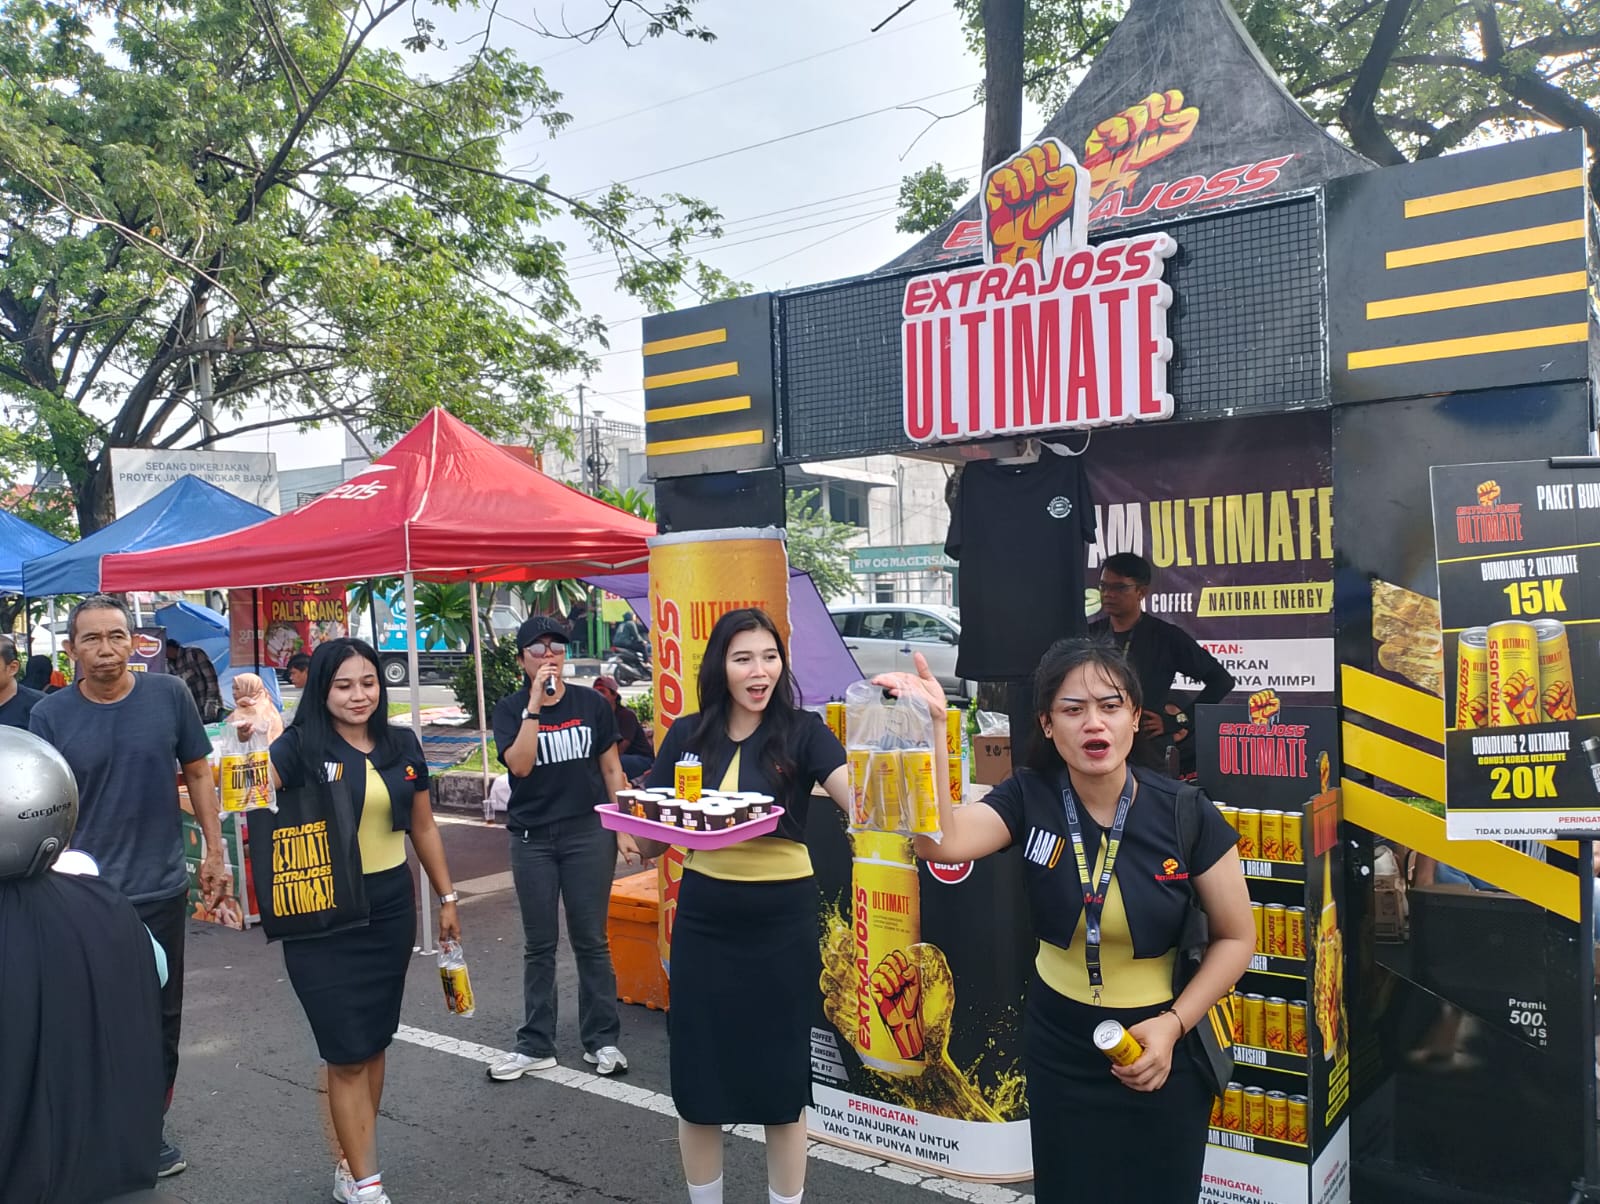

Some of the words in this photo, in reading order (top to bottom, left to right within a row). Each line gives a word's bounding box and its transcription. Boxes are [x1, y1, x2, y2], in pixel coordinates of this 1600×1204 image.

[904, 239, 1158, 316] EXTRAJOSS
[905, 283, 1162, 440] ULTIMATE
[119, 473, 161, 482] PROYEK
[243, 475, 273, 483] BARAT
[146, 462, 187, 471] SEDANG
[190, 463, 250, 472] DIKERJAKAN
[1537, 484, 1573, 510] PAKET
[1150, 487, 1334, 568] ULTIMATE
[1456, 512, 1524, 544] ULTIMATE
[1481, 558, 1526, 581] BUNDLING
[1528, 559, 1535, 577] 2
[1536, 554, 1579, 576] ULTIMATE
[1152, 593, 1193, 613] COFFEE
[1209, 590, 1267, 611] NATURAL
[1274, 588, 1324, 609] ENERGY
[1503, 579, 1567, 616] 15K
[271, 599, 345, 622] PALEMBANG
[1502, 637, 1530, 650] ULTIMATE
[1268, 675, 1316, 686] MIMPI
[1219, 723, 1305, 737] EXTRAJOSS
[1472, 734, 1517, 755] BUNDLING
[1519, 739, 1526, 754] 2
[1528, 731, 1570, 753] ULTIMATE
[1219, 736, 1308, 778] ULTIMATE
[1478, 755, 1504, 765] BONUS
[1531, 752, 1567, 763] ULTIMATE
[1490, 765, 1557, 800] 20K
[272, 864, 332, 885] EXTRAJOSS
[1247, 862, 1272, 877] DREAM
[872, 890, 910, 915] ULTIMATE
[857, 884, 871, 1051] EXTRAJOSS
[811, 1031, 833, 1043] COFFEE
[1233, 1046, 1267, 1066] SATISFIED
[848, 1099, 918, 1126] PERINGATAN:
[815, 1104, 845, 1120] TIDAK
[847, 1112, 916, 1141] DIANJURKAN
[919, 1132, 960, 1152] UNTUK
[822, 1120, 850, 1137] YANG
[853, 1130, 873, 1144] TAK
[876, 1136, 912, 1154] PUNYA
[915, 1146, 950, 1164] MIMPI
[1222, 1131, 1255, 1152] ULTIMATE
